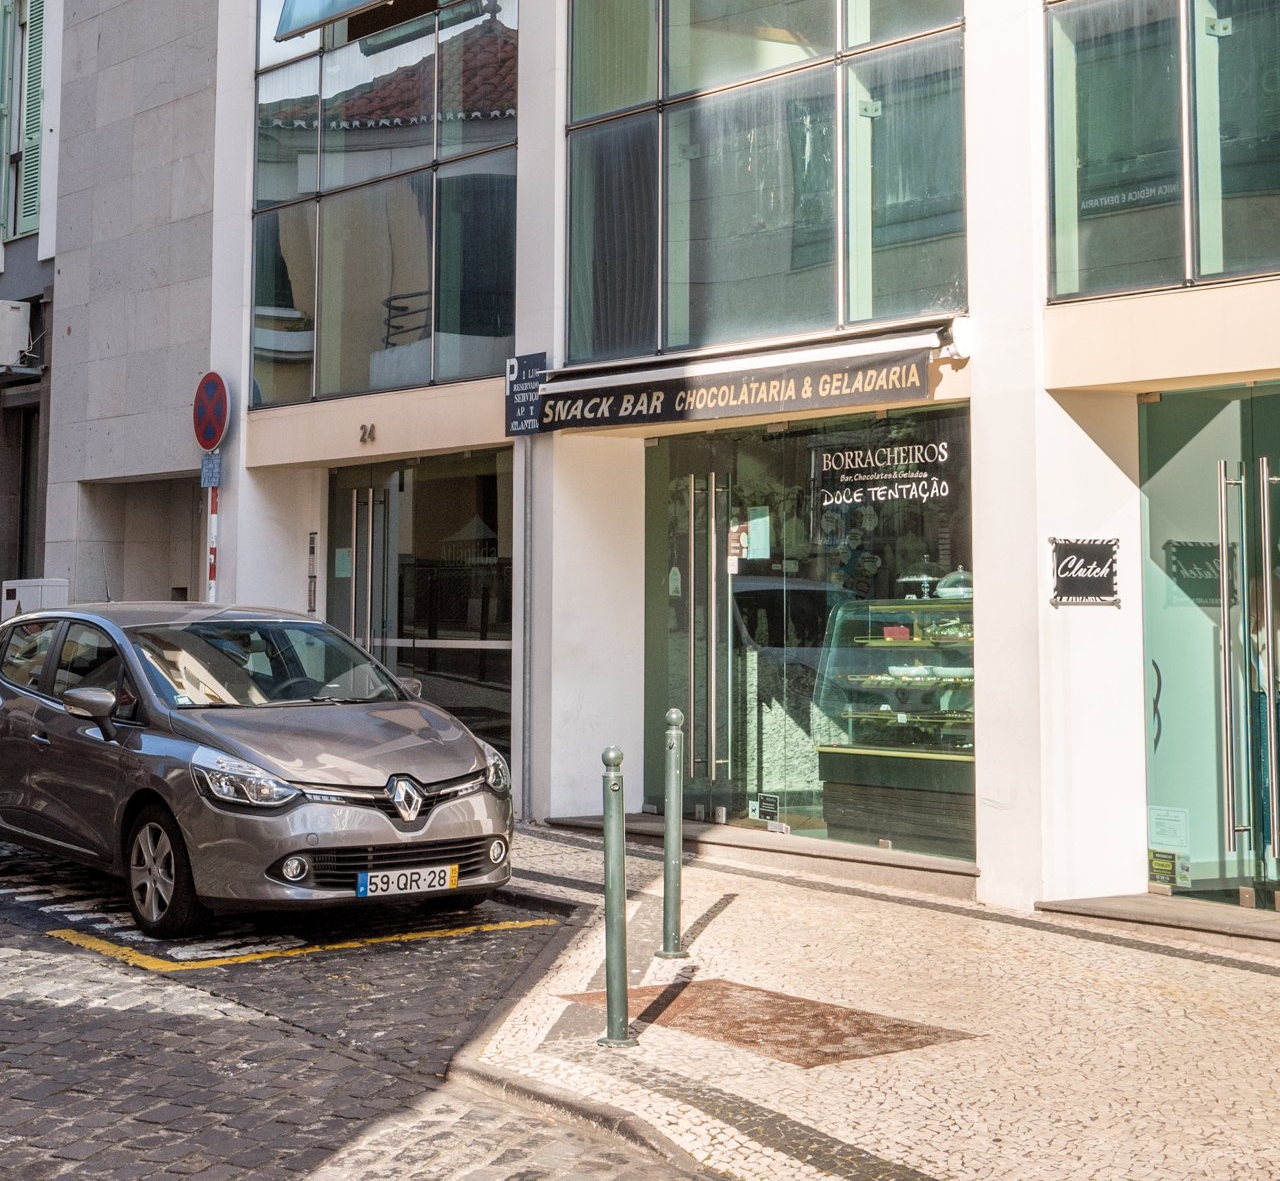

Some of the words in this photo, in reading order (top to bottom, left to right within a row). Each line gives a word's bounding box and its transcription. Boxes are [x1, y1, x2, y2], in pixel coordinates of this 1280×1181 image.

[506, 358, 518, 396] P
[543, 396, 615, 424] SNACK
[619, 390, 666, 417] BAR
[675, 378, 796, 412] CHOCOLATARIA
[801, 376, 812, 399] &
[818, 364, 921, 396] GELADARIA
[359, 423, 376, 444] 24
[822, 442, 948, 471] BORRACHEIROS
[898, 470, 928, 479] Gelados
[821, 488, 864, 506] DOCE
[867, 477, 949, 503] TENTAÇÃO
[1057, 555, 1113, 579] Clutch
